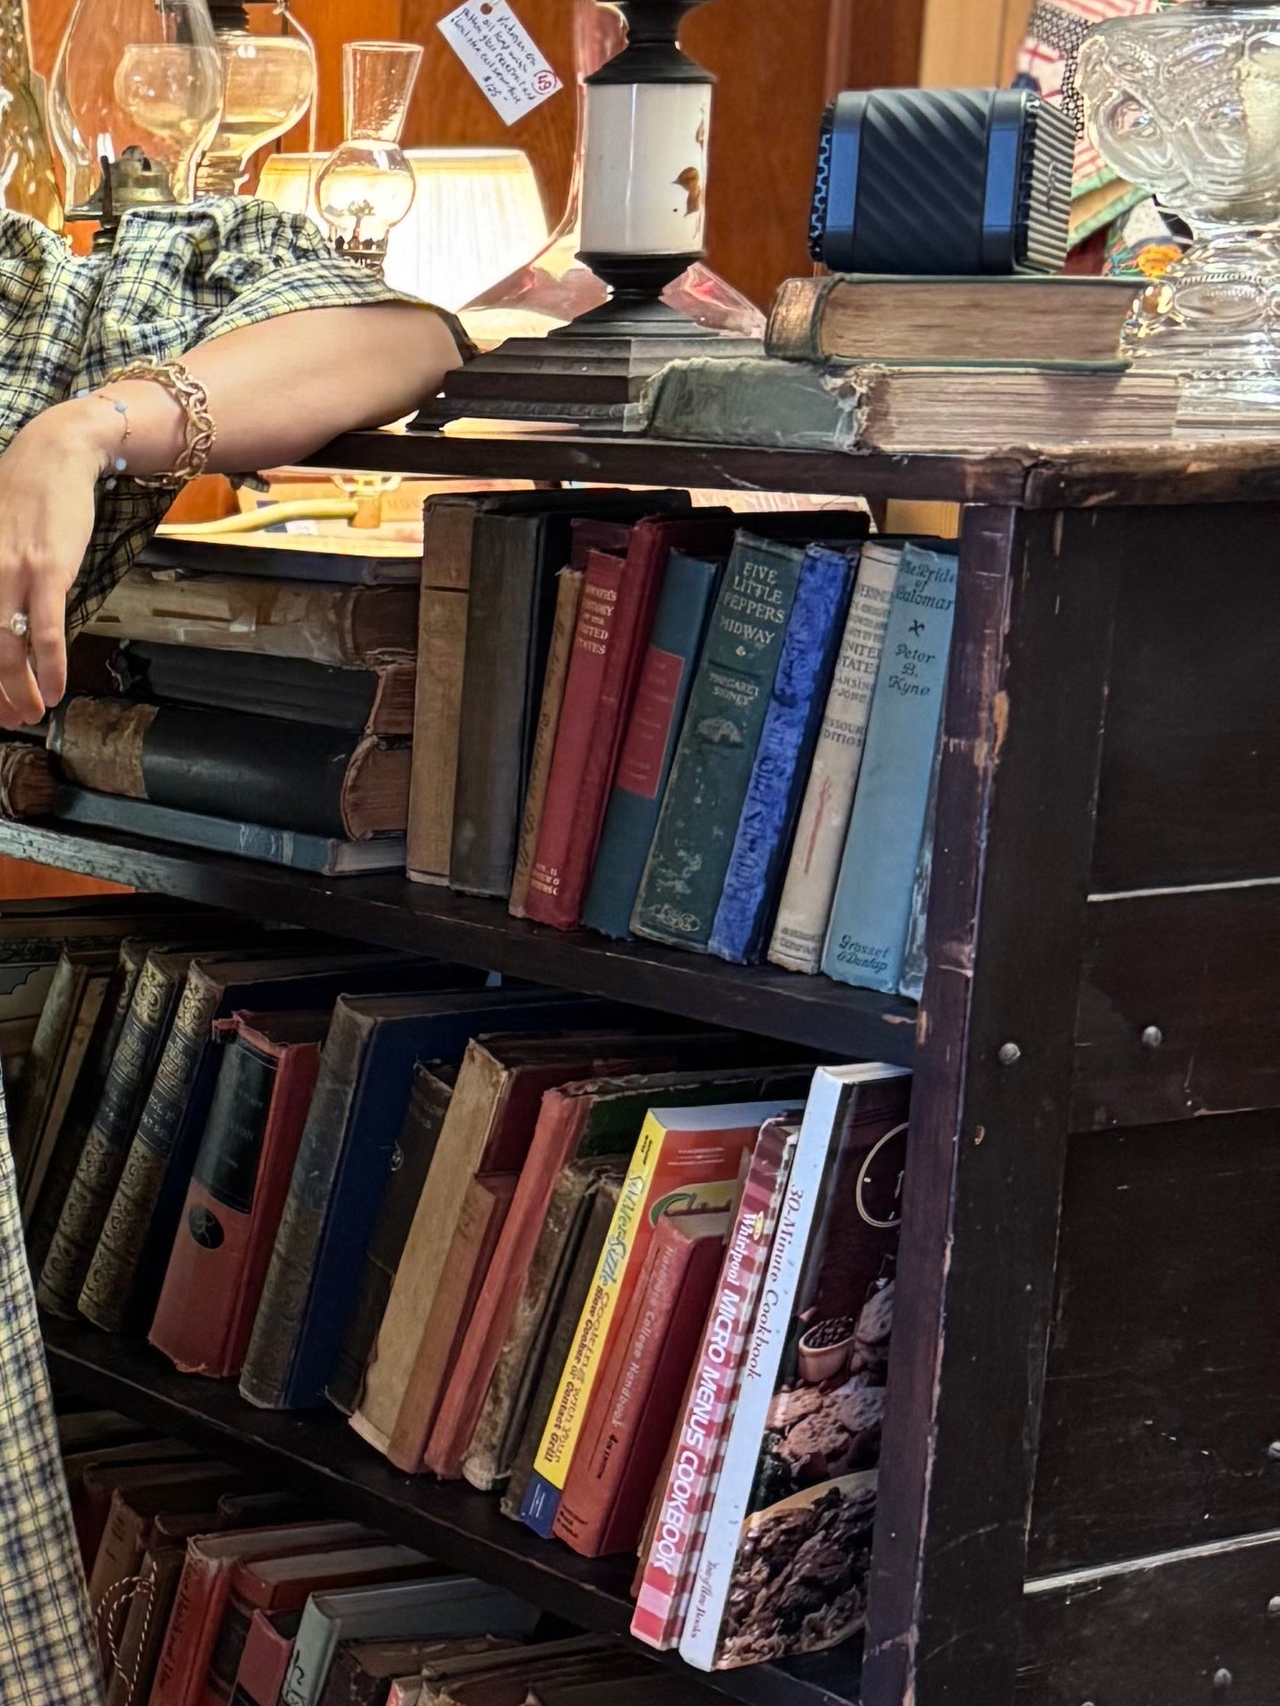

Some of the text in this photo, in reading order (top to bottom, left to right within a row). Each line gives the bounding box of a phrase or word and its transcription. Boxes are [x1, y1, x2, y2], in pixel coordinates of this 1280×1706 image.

[733, 575, 783, 604] LITTLE
[742, 561, 778, 585] FIVE
[722, 592, 785, 624] PEPPERS
[895, 643, 936, 665] Peter
[746, 1183, 807, 1382] 30-Minute Cookbook
[572, 1317, 596, 1365] Cooker
[630, 1309, 657, 1360] College
[552, 1380, 576, 1431] Contact
[609, 1361, 641, 1428] Handbook
[651, 1210, 761, 1573] Whirlpool MICRO MENUS COOKBOOK
[542, 1432, 561, 1463] Grill
